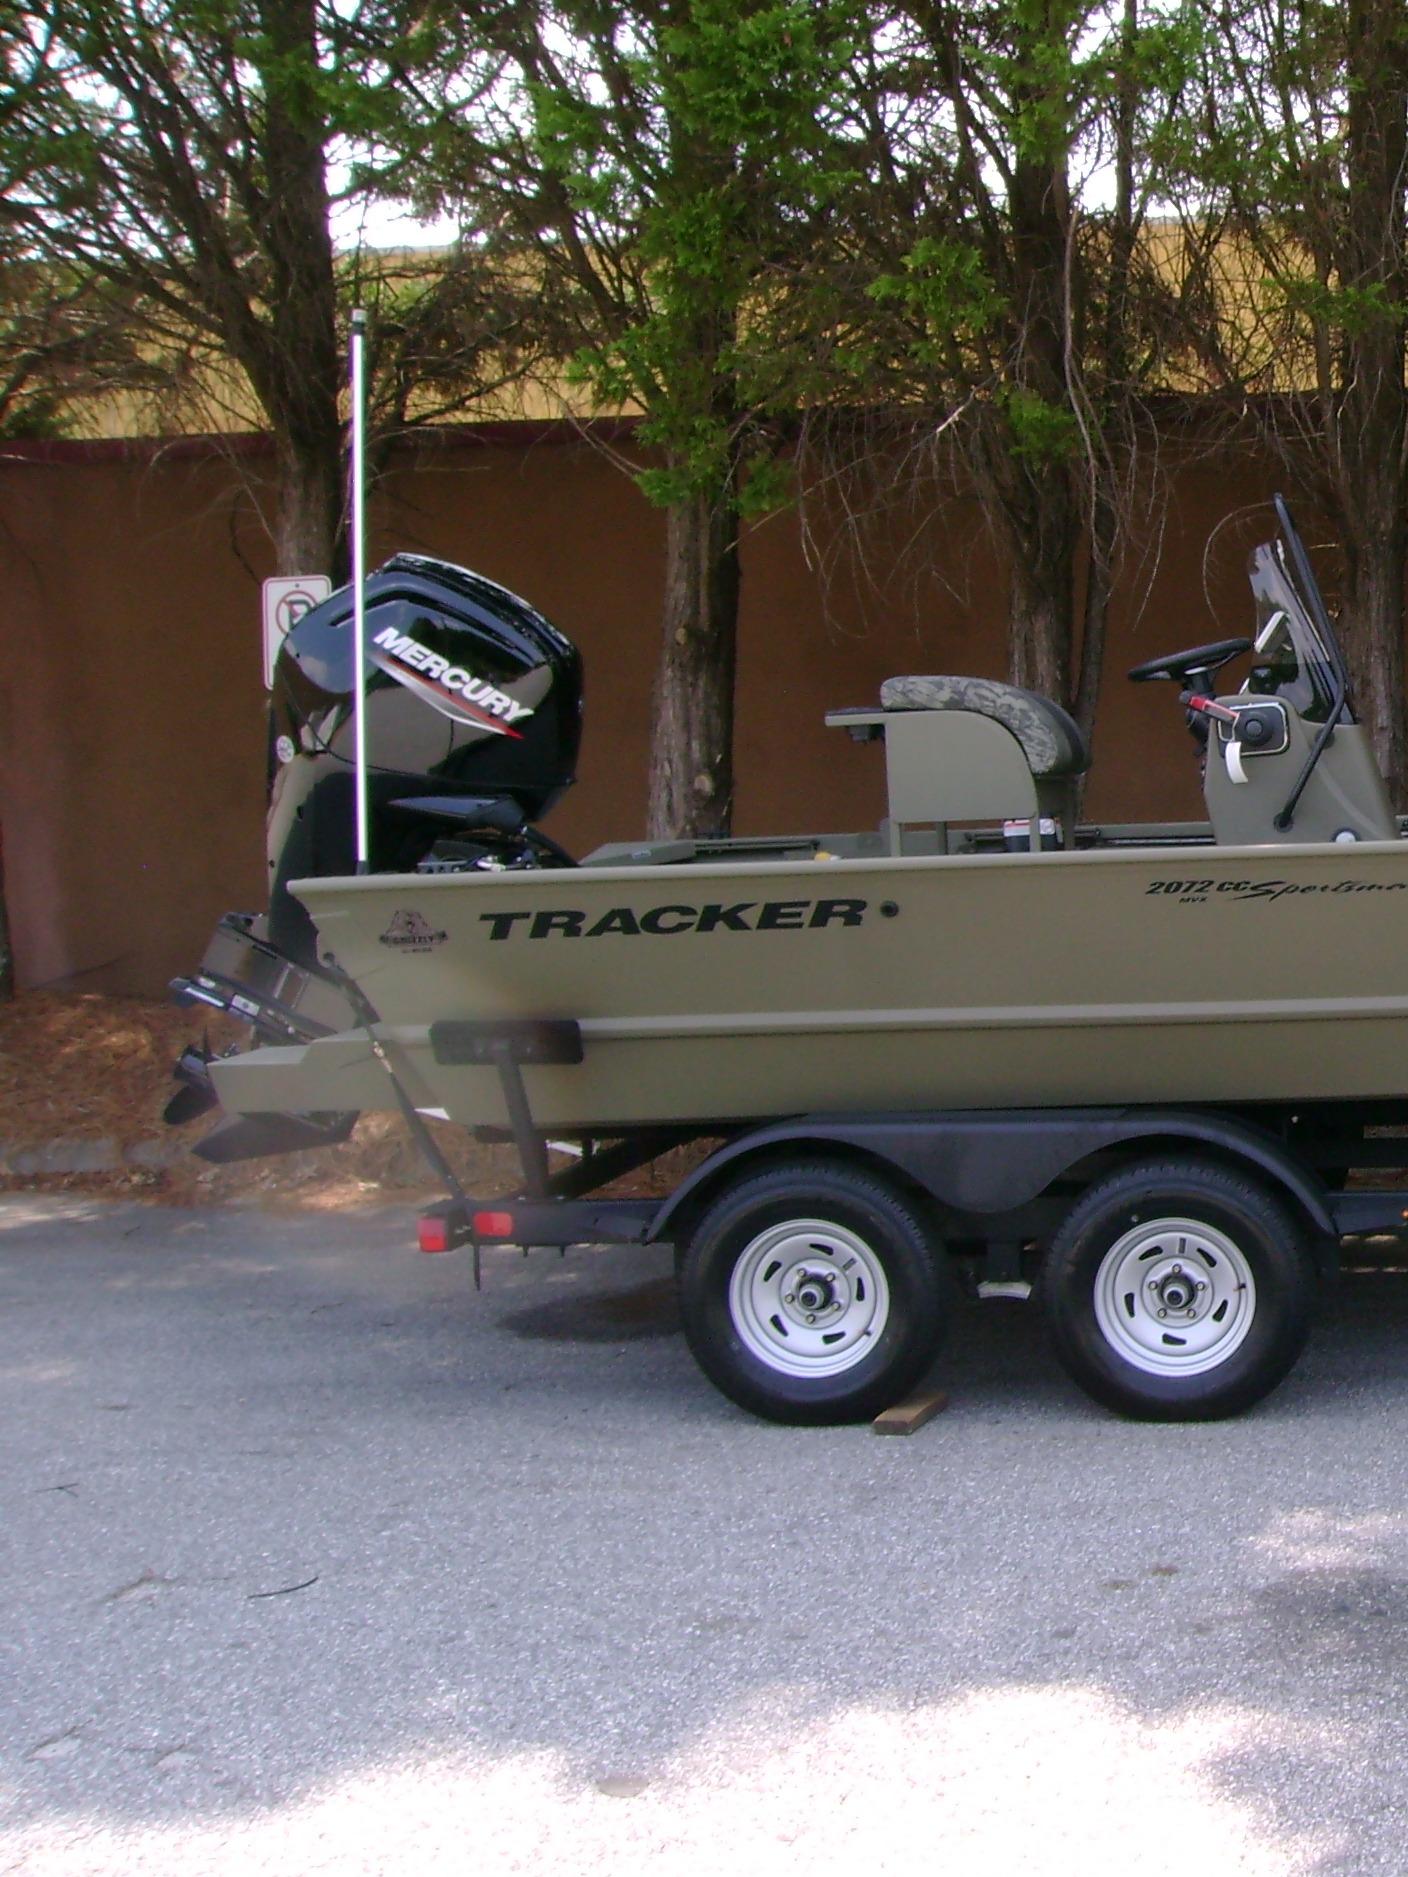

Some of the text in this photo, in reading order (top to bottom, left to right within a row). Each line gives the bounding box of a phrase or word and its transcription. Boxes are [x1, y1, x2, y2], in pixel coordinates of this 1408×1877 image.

[373, 626, 535, 722] MERCURY
[1145, 880, 1215, 895] 2072
[1216, 880, 1250, 892] CC
[479, 899, 868, 941] TRACKER
